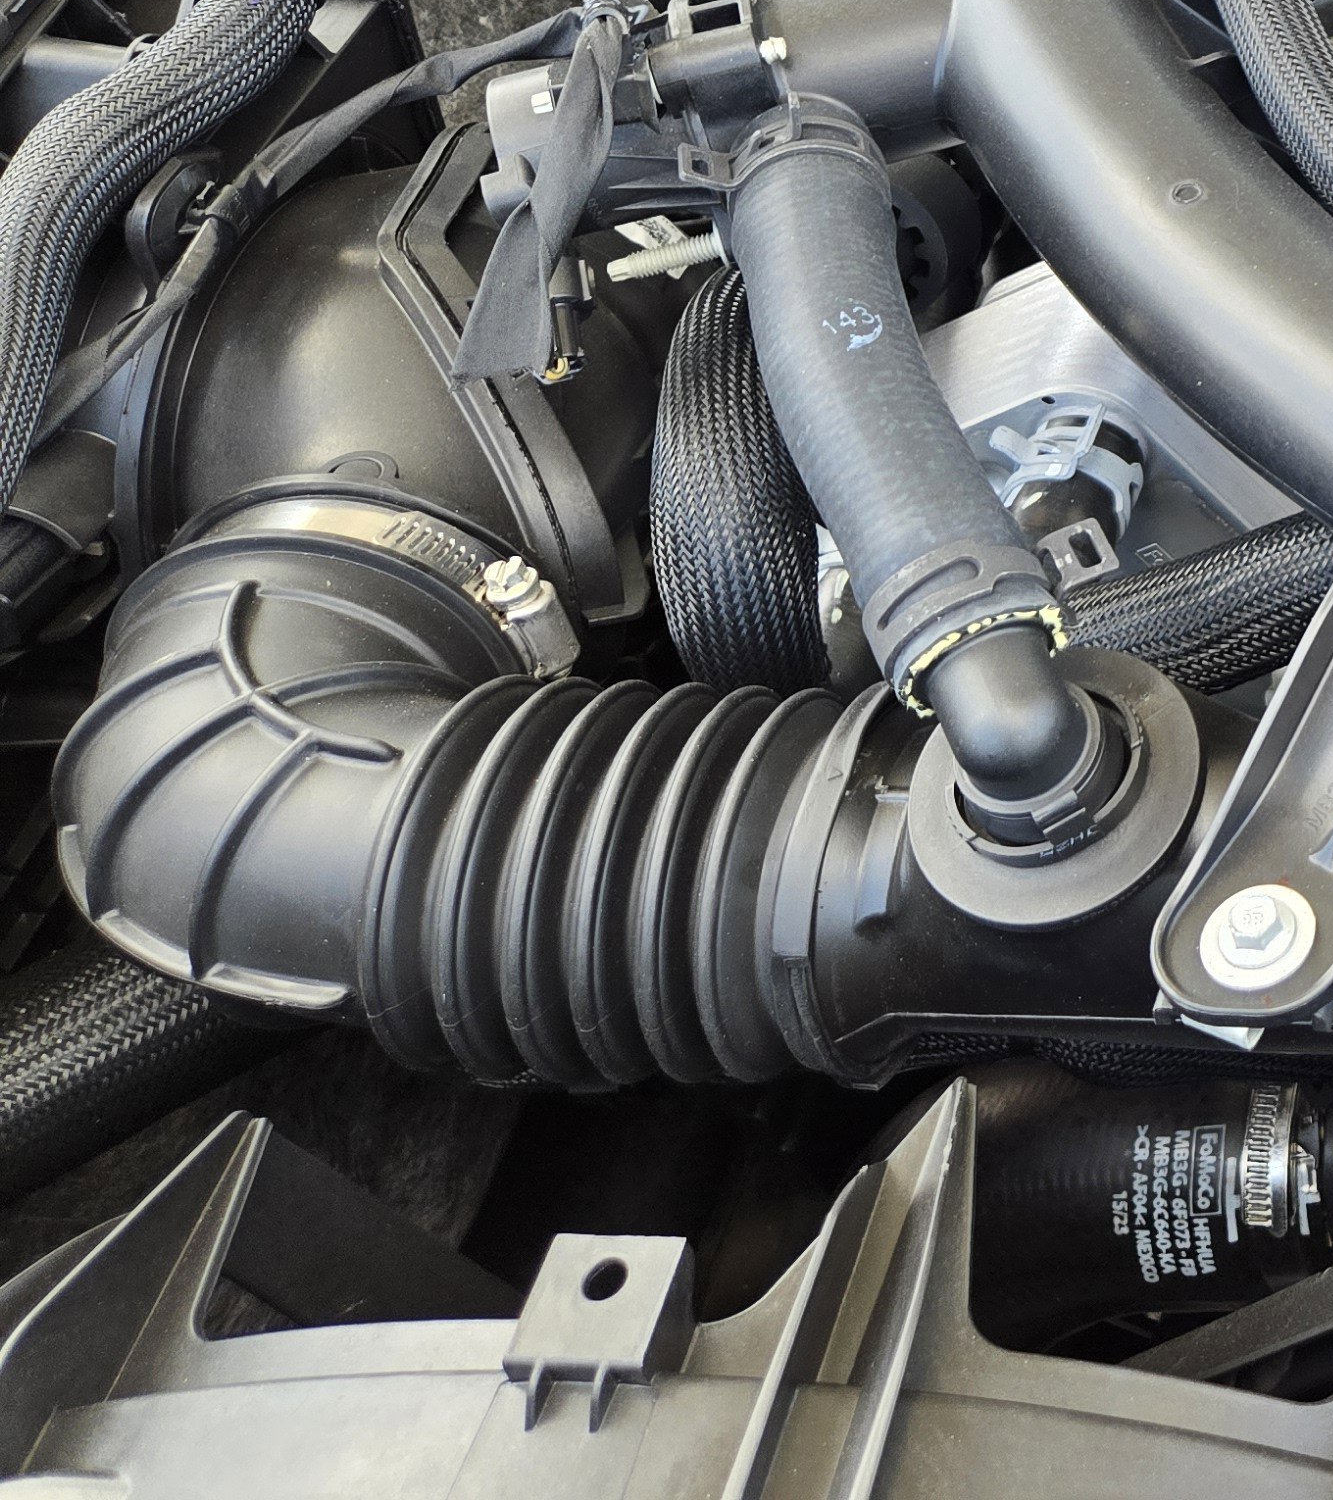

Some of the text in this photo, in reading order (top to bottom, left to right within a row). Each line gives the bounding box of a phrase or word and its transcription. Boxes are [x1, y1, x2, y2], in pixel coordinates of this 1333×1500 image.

[1111, 1189, 1131, 1236] 15/23
[1193, 1132, 1219, 1275] FoMoCo HFHUA
[1134, 1229, 1161, 1284] MEXICO
